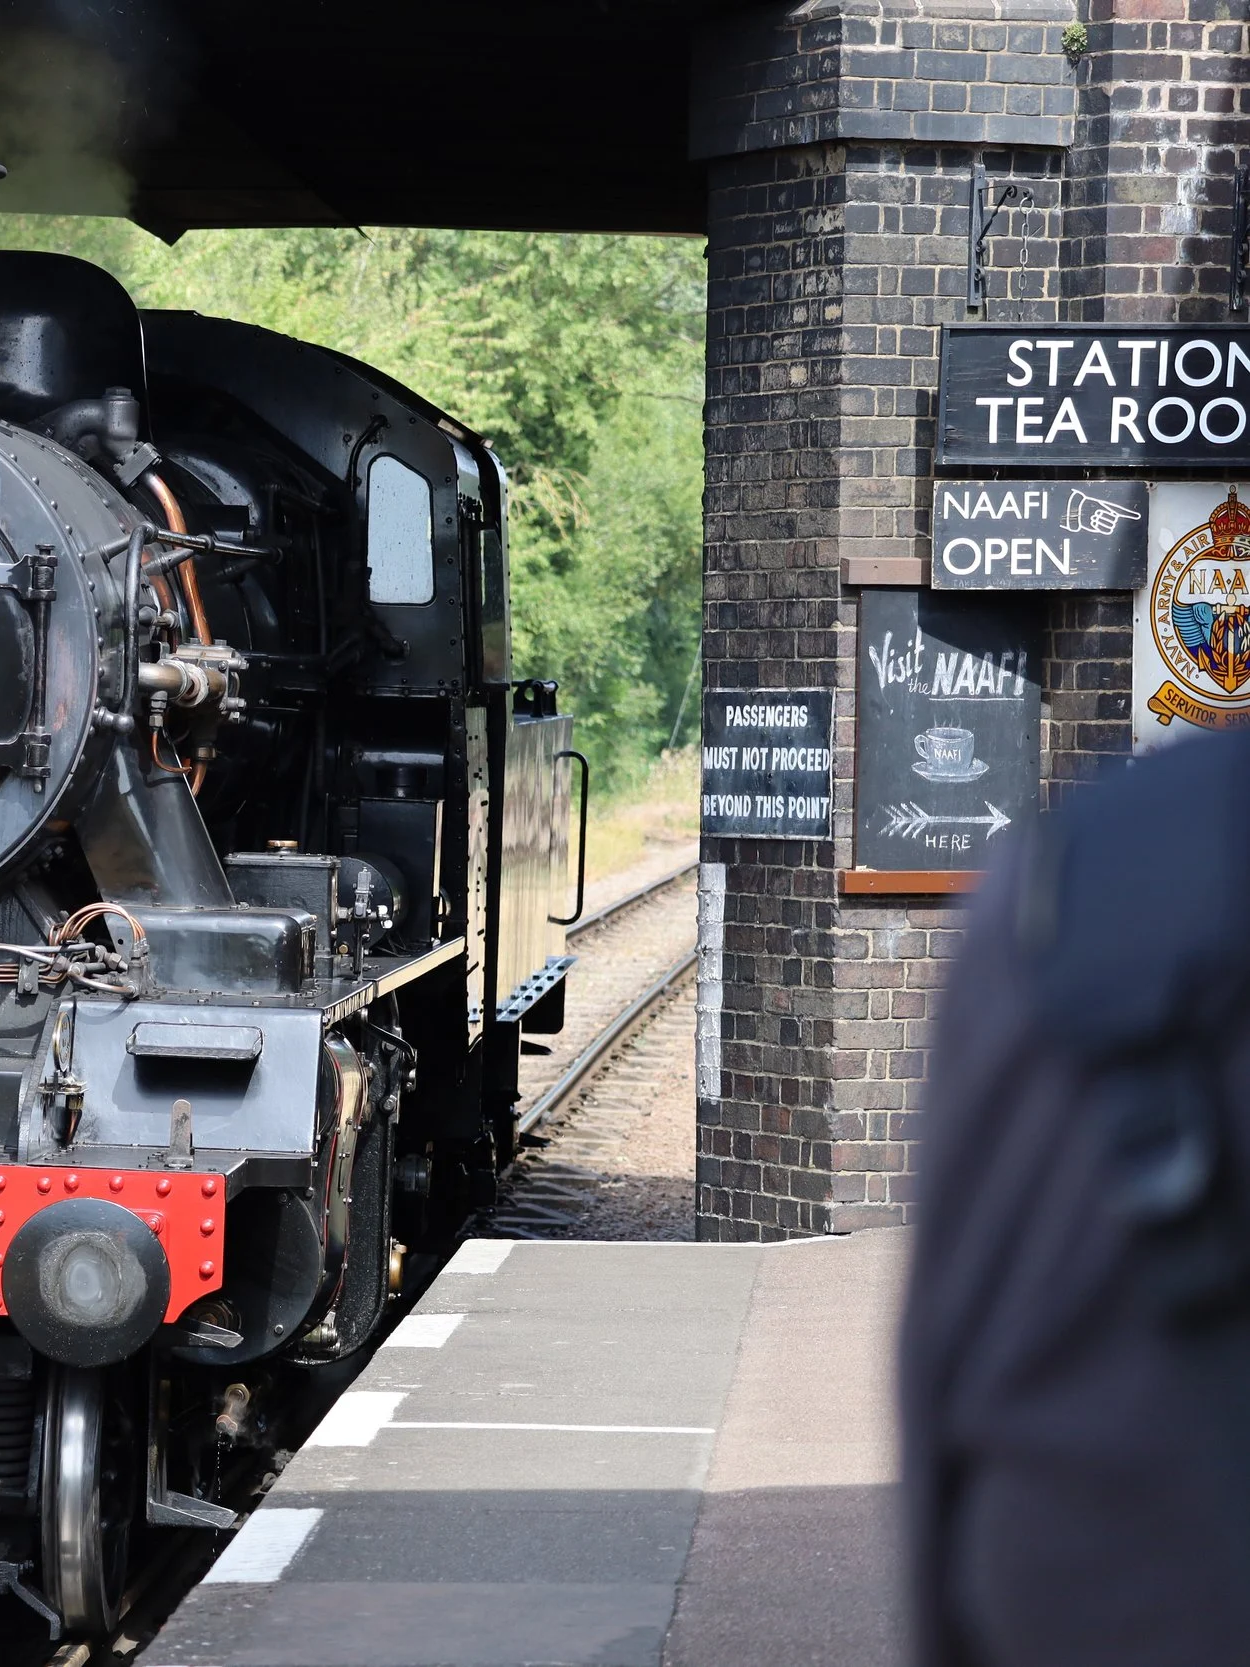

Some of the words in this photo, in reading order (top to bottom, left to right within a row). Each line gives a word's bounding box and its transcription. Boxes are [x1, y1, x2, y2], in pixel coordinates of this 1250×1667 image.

[975, 396, 1088, 444] TEA
[943, 491, 1049, 520] NAAFI
[942, 537, 1071, 576] OPEN
[1182, 533, 1211, 561] AIR
[1158, 569, 1177, 626] ARMY
[868, 625, 925, 688] Visit
[908, 677, 932, 694] the
[931, 651, 1028, 696] NAAFI
[1161, 635, 1196, 679] NAVY
[726, 705, 808, 727] PASSENGERS
[1164, 688, 1217, 725] SERVITOR
[704, 747, 738, 769] MUST
[742, 747, 768, 771] NOT
[771, 747, 830, 772] PROCEED
[934, 749, 961, 760] NAAFI
[703, 794, 752, 817] BEYOND
[755, 796, 785, 818] THIS
[788, 796, 829, 819] POINT
[925, 834, 971, 850] HERE
